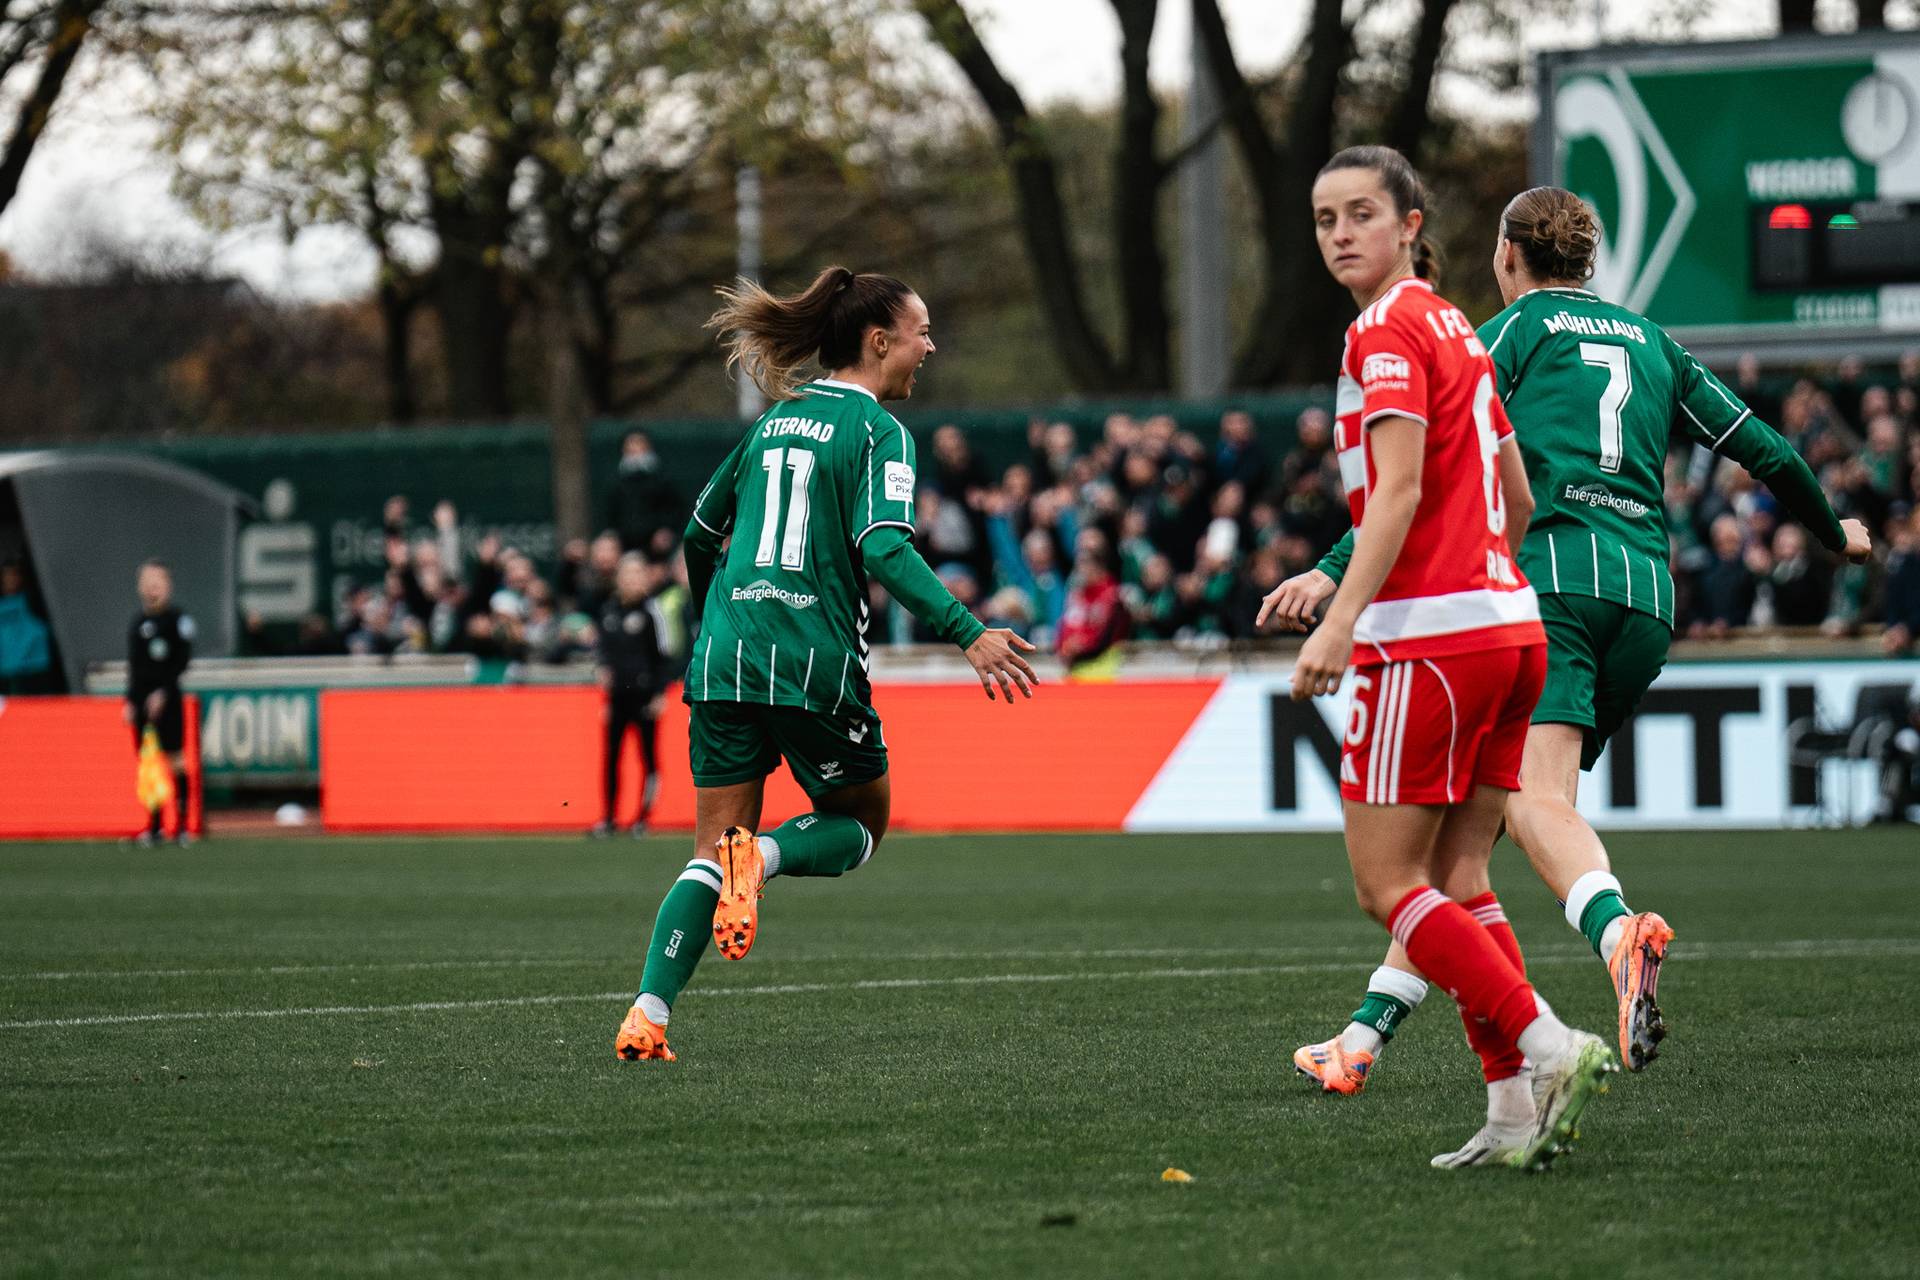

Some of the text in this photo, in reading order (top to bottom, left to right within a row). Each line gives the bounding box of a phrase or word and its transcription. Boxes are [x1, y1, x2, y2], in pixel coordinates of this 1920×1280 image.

[1543, 311, 1647, 344] MÜHLHAUS
[1579, 342, 1632, 474] 7
[762, 416, 835, 443] STERNAD
[888, 472, 912, 485] Goo
[895, 485, 912, 494] Pix
[755, 447, 816, 571] 11
[1564, 485, 1648, 514] Energiekontor
[731, 585, 815, 605] Energiekontor
[1346, 675, 1372, 747] 6
